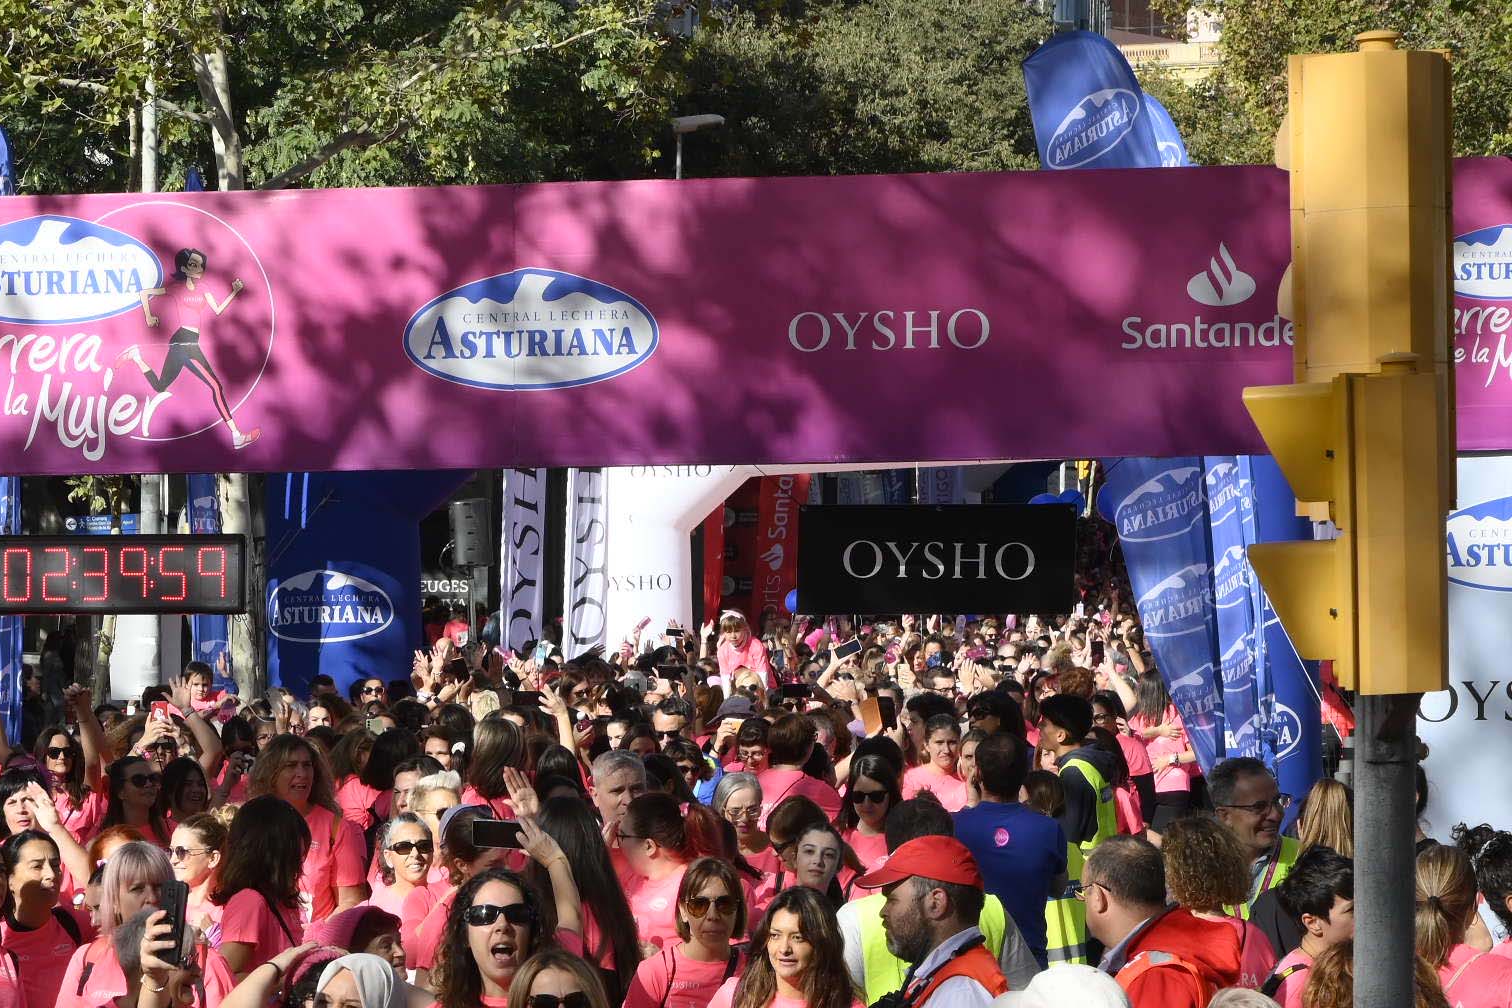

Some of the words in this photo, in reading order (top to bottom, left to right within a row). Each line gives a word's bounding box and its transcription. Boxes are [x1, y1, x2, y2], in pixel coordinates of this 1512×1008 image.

[423, 314, 639, 361] ASTURIANA
[463, 312, 540, 324] CENTRAL
[550, 309, 630, 322] LECHERA
[788, 309, 991, 352] OYSHO
[4, 376, 29, 416] la
[24, 370, 172, 461] Mujer
[3, 547, 226, 602] 02:39:59
[842, 540, 1037, 582] OYSHO
[608, 574, 672, 591] YSHO
[272, 593, 384, 625] ASTURIANA
